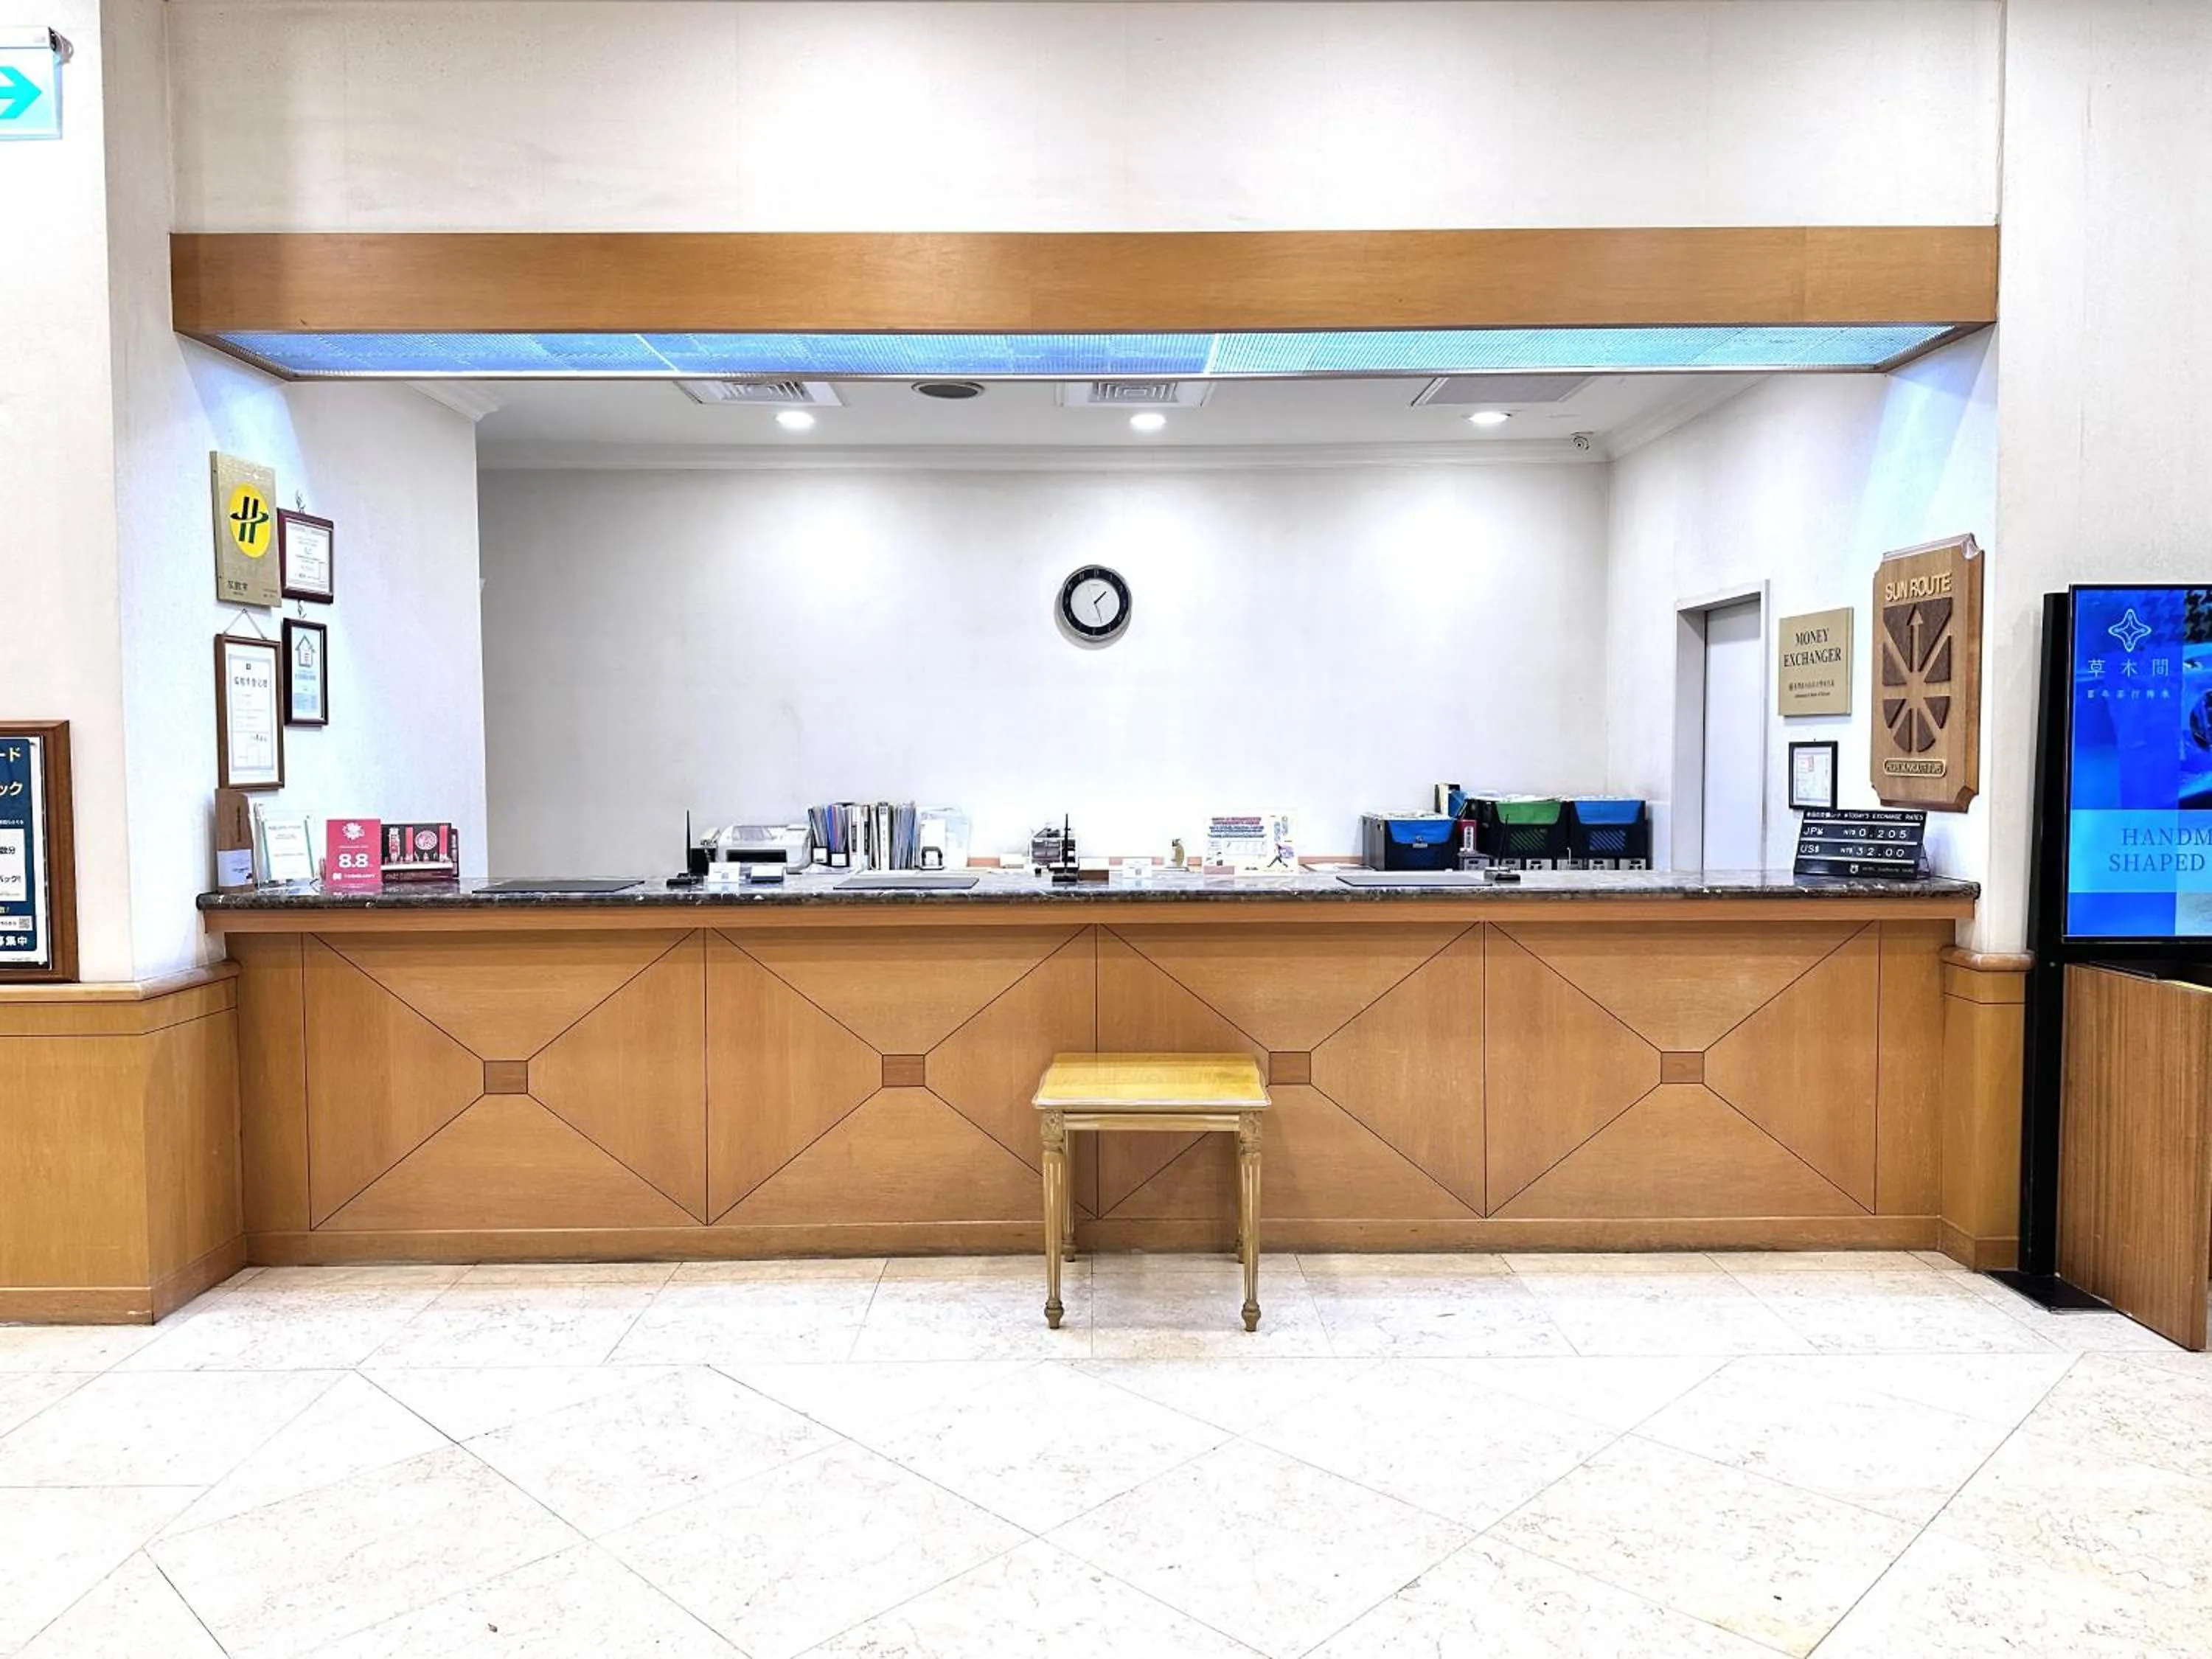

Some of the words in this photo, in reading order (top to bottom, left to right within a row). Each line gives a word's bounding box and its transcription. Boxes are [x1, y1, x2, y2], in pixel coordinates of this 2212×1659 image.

[1886, 582, 1907, 602] SUN
[1910, 572, 1952, 598] ROUTE
[1795, 627, 1829, 646] MONEY
[1784, 647, 1841, 667] EXCHANGER
[1859, 828, 1908, 838] 0.205
[338, 853, 369, 868] 8.8
[1856, 847, 1905, 857] 32.00
[2109, 853, 2205, 872] SHAPED
